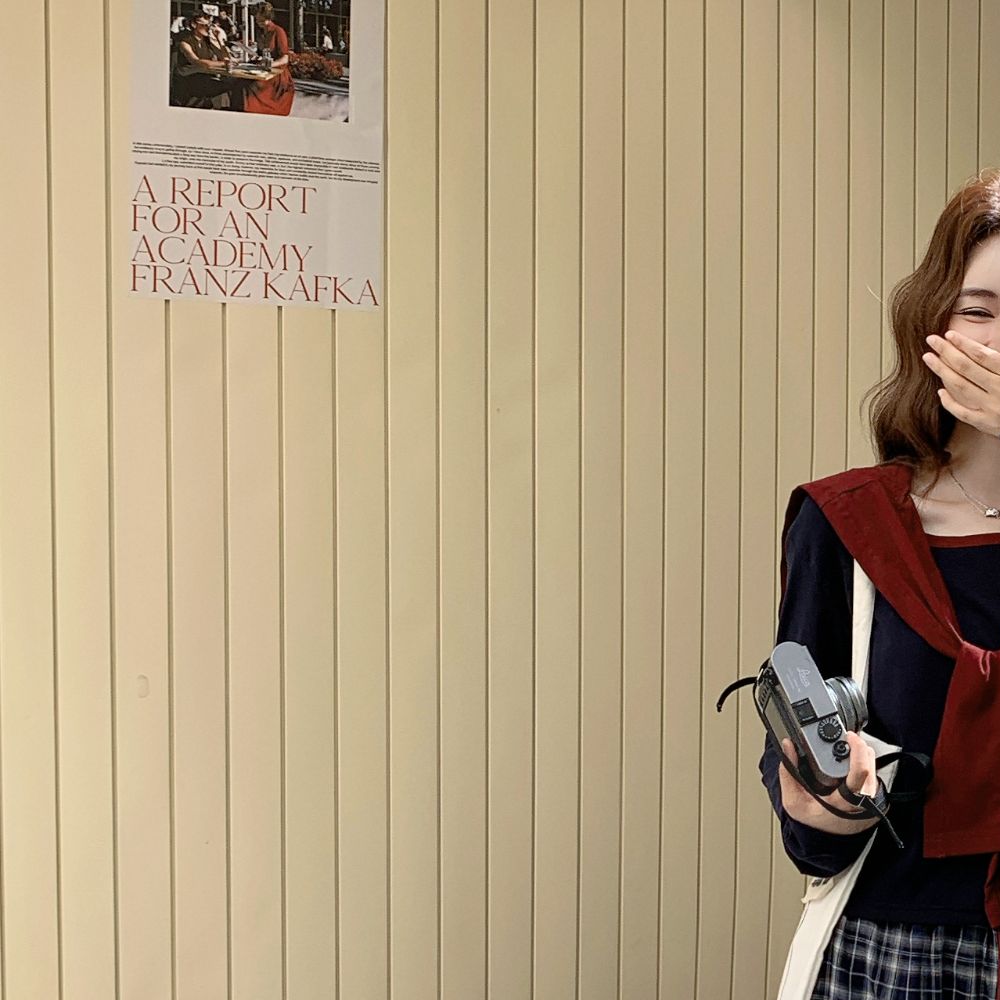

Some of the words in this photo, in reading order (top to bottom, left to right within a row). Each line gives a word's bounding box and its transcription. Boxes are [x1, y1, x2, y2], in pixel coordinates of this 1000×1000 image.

[132, 174, 157, 203] A
[170, 176, 317, 214] REPORT
[132, 203, 206, 236] FOR
[218, 210, 270, 240] AN
[131, 234, 313, 272] ACADEMY
[130, 263, 252, 298] FRANZ
[262, 271, 380, 306] KAFKA
